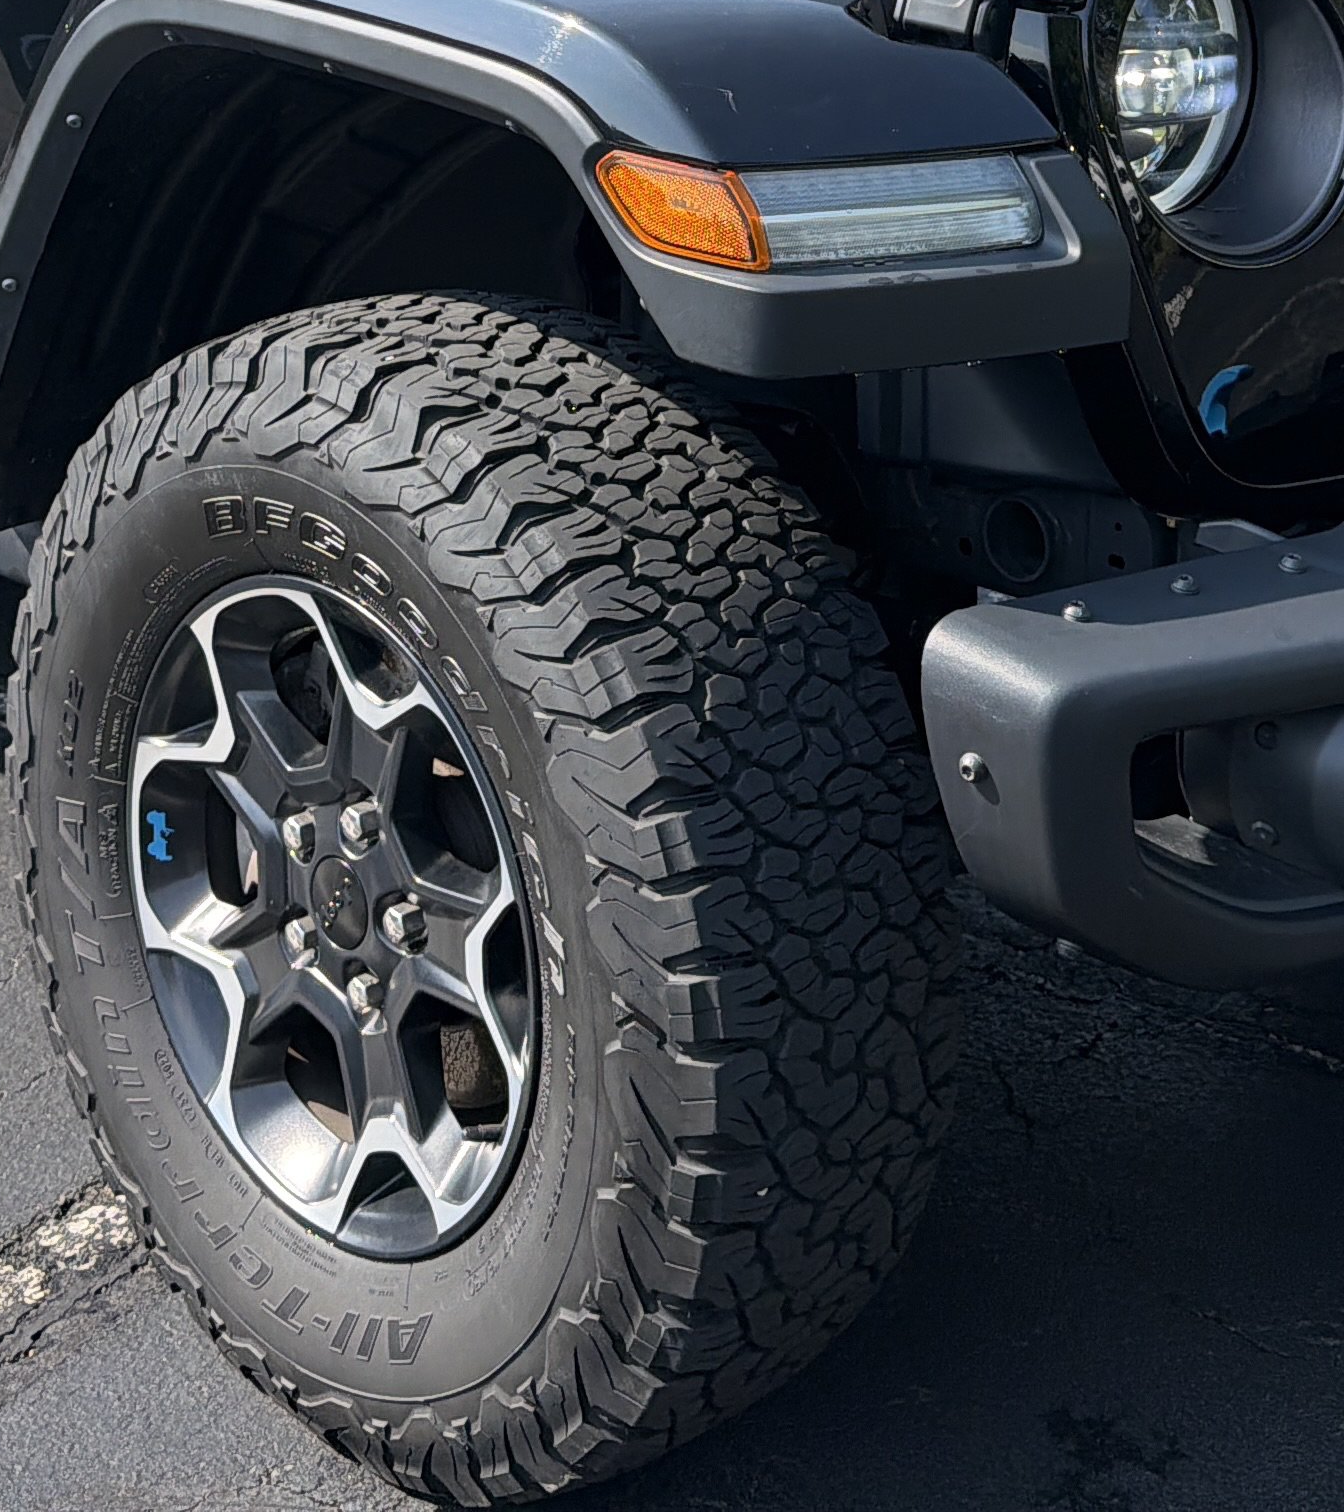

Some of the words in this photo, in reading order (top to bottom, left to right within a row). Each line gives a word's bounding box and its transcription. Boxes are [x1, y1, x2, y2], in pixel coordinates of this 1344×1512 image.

[54, 794, 106, 976] T/A
[202, 495, 567, 997] BFGoodrich
[92, 994, 433, 1366] All-Terrain
